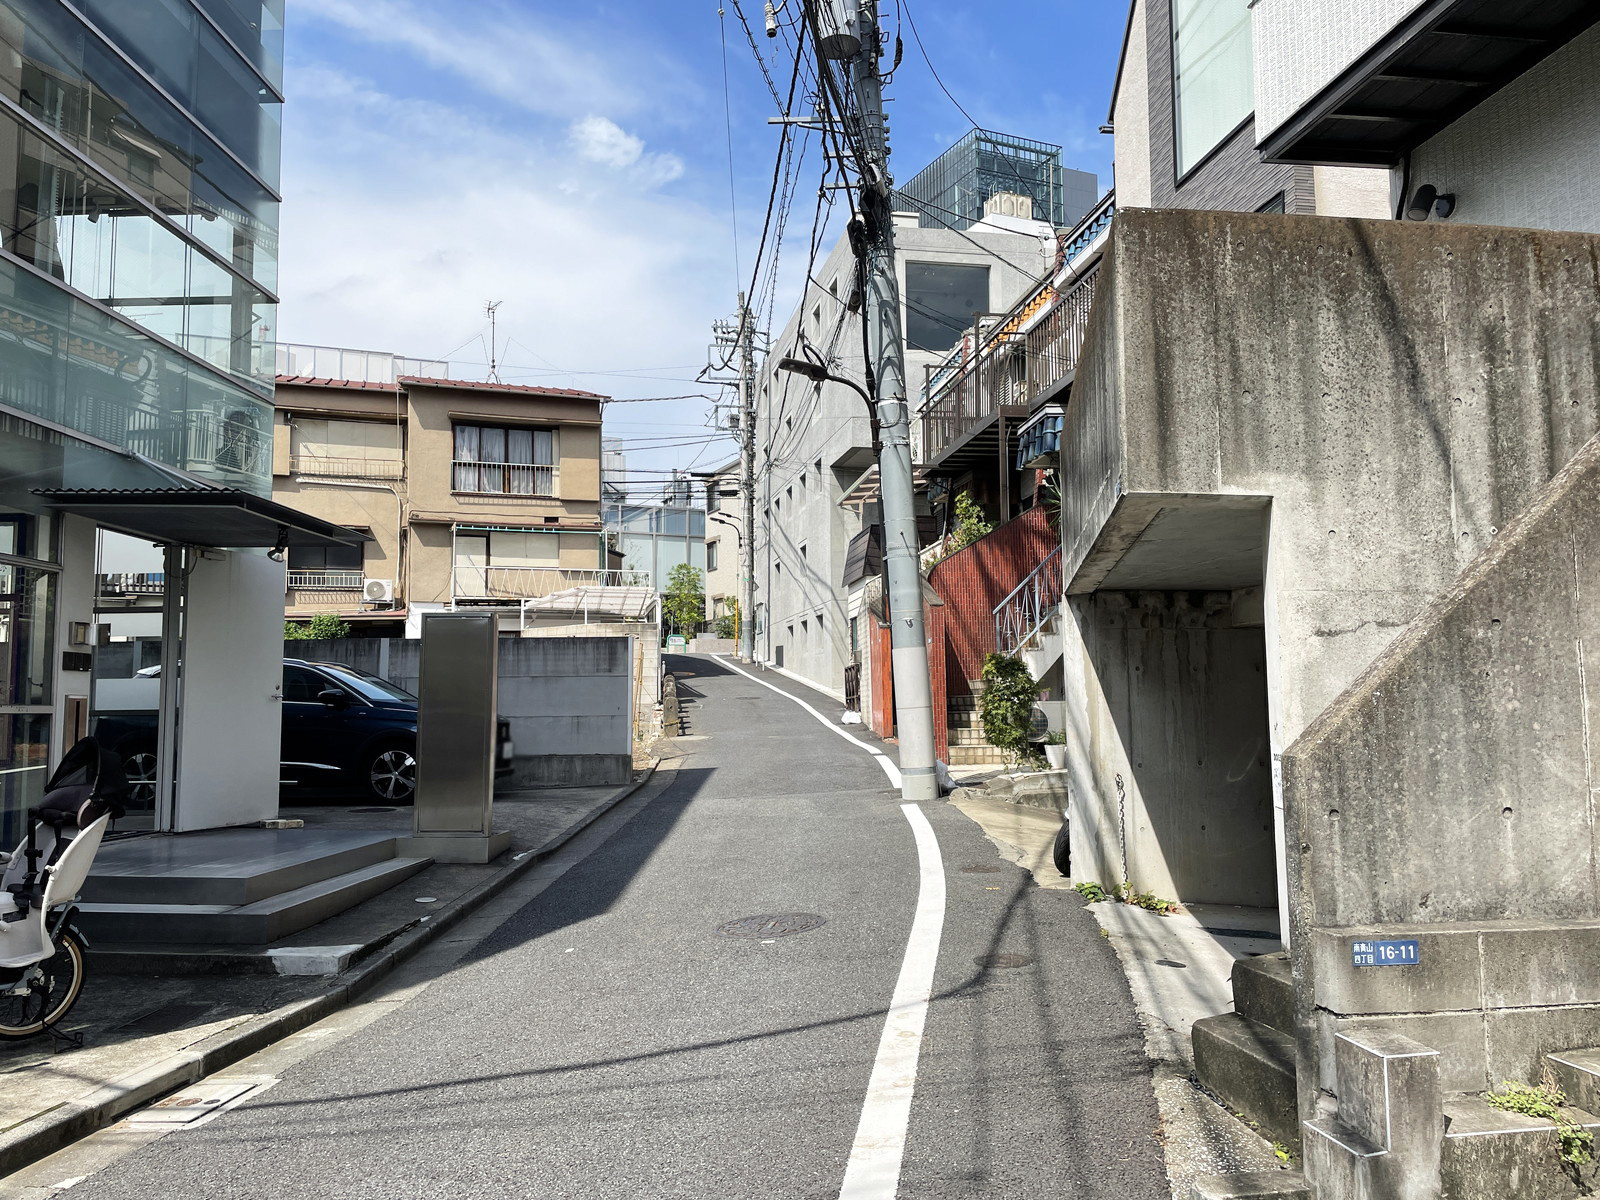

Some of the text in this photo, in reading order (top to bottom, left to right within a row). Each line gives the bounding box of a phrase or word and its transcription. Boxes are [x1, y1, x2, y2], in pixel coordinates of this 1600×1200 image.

[1353, 942, 1373, 953] 南青山
[1379, 945, 1414, 960] 16-11
[1354, 954, 1374, 964] 四丁目
